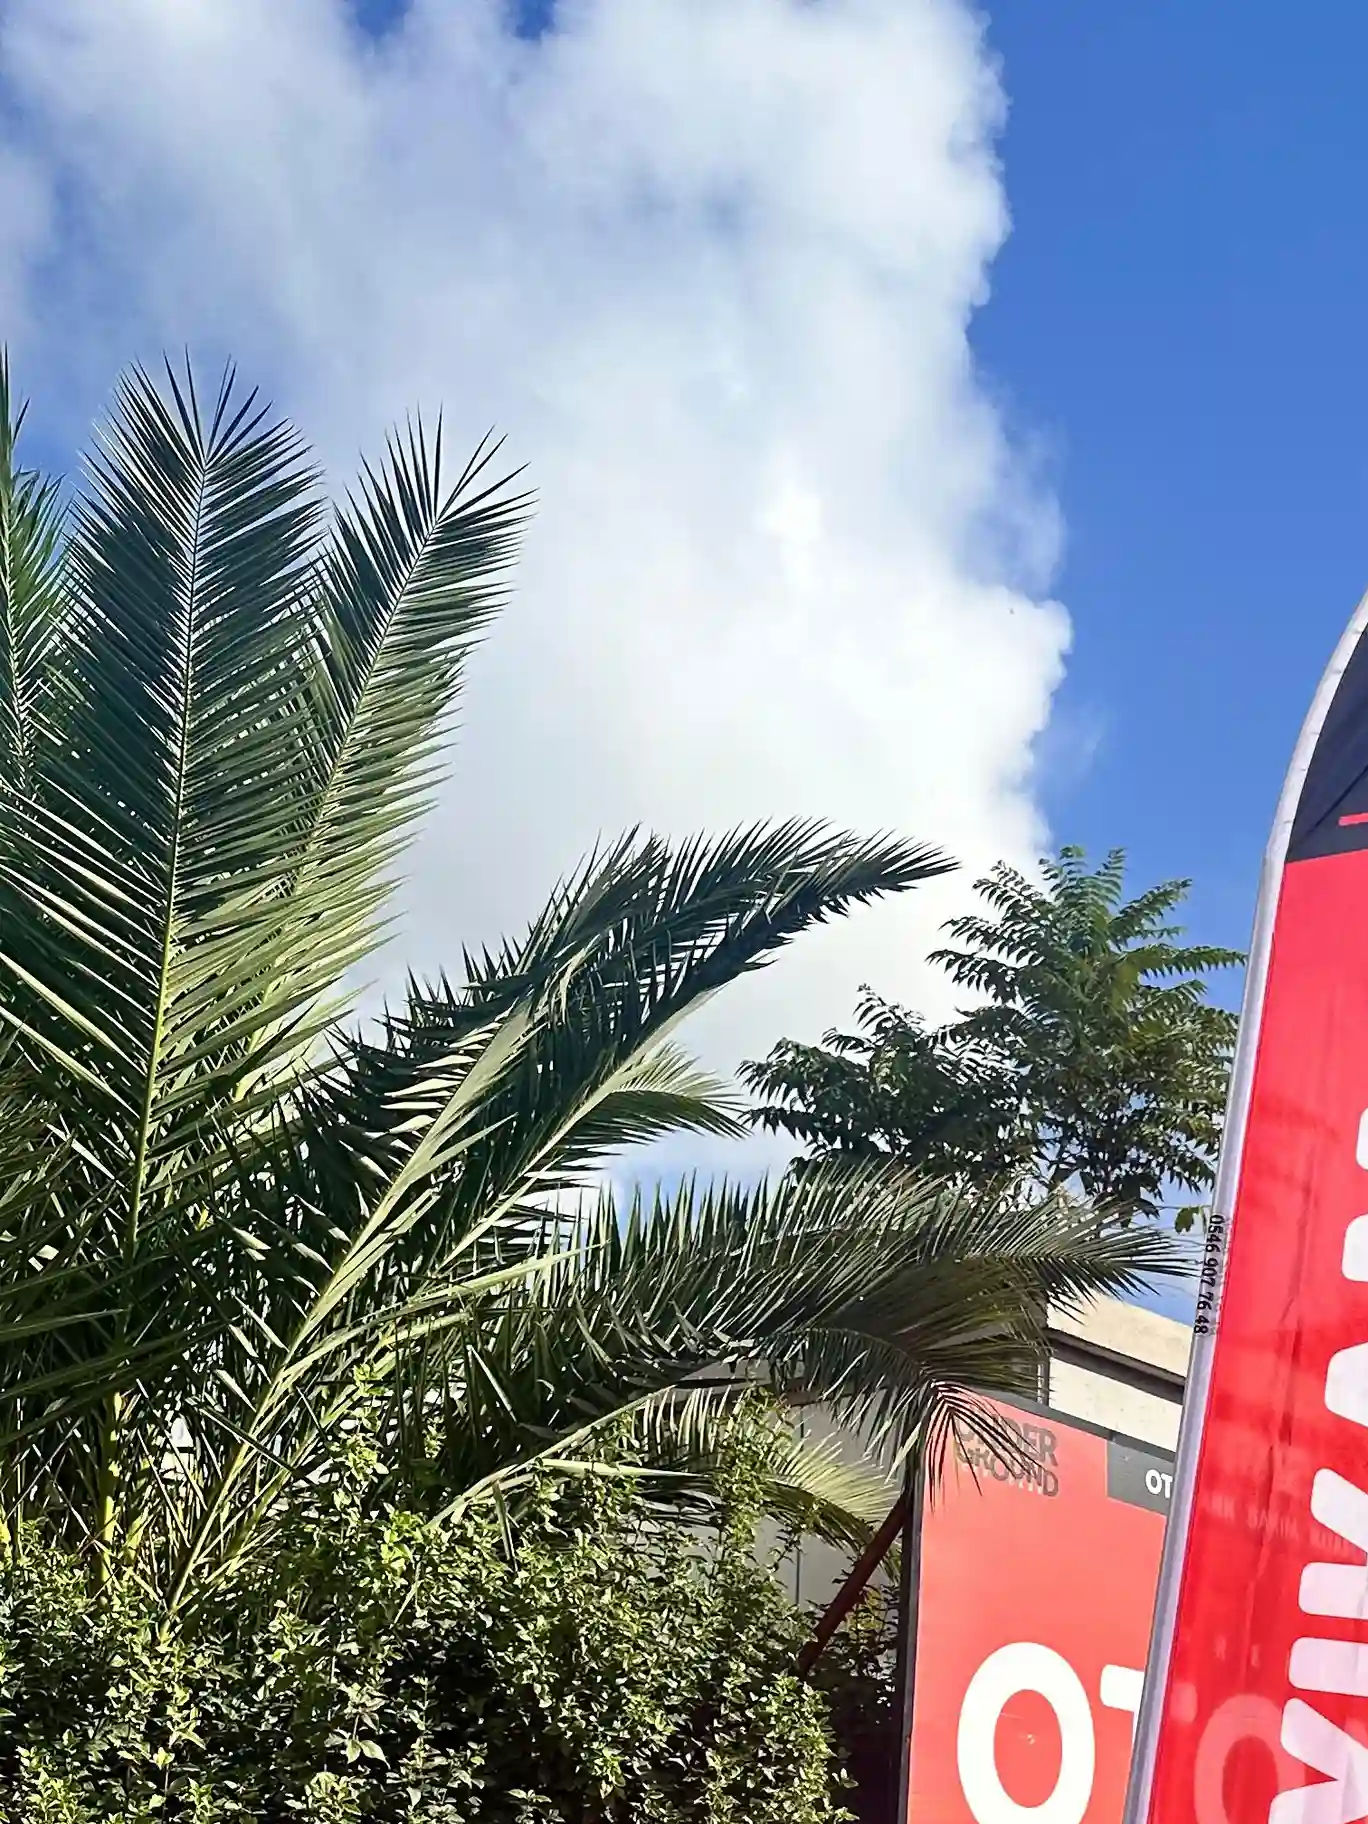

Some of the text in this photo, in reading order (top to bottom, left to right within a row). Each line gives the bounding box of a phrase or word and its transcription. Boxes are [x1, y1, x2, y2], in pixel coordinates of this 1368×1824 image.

[1194, 1214, 1225, 1334] 0546 907 76 48
